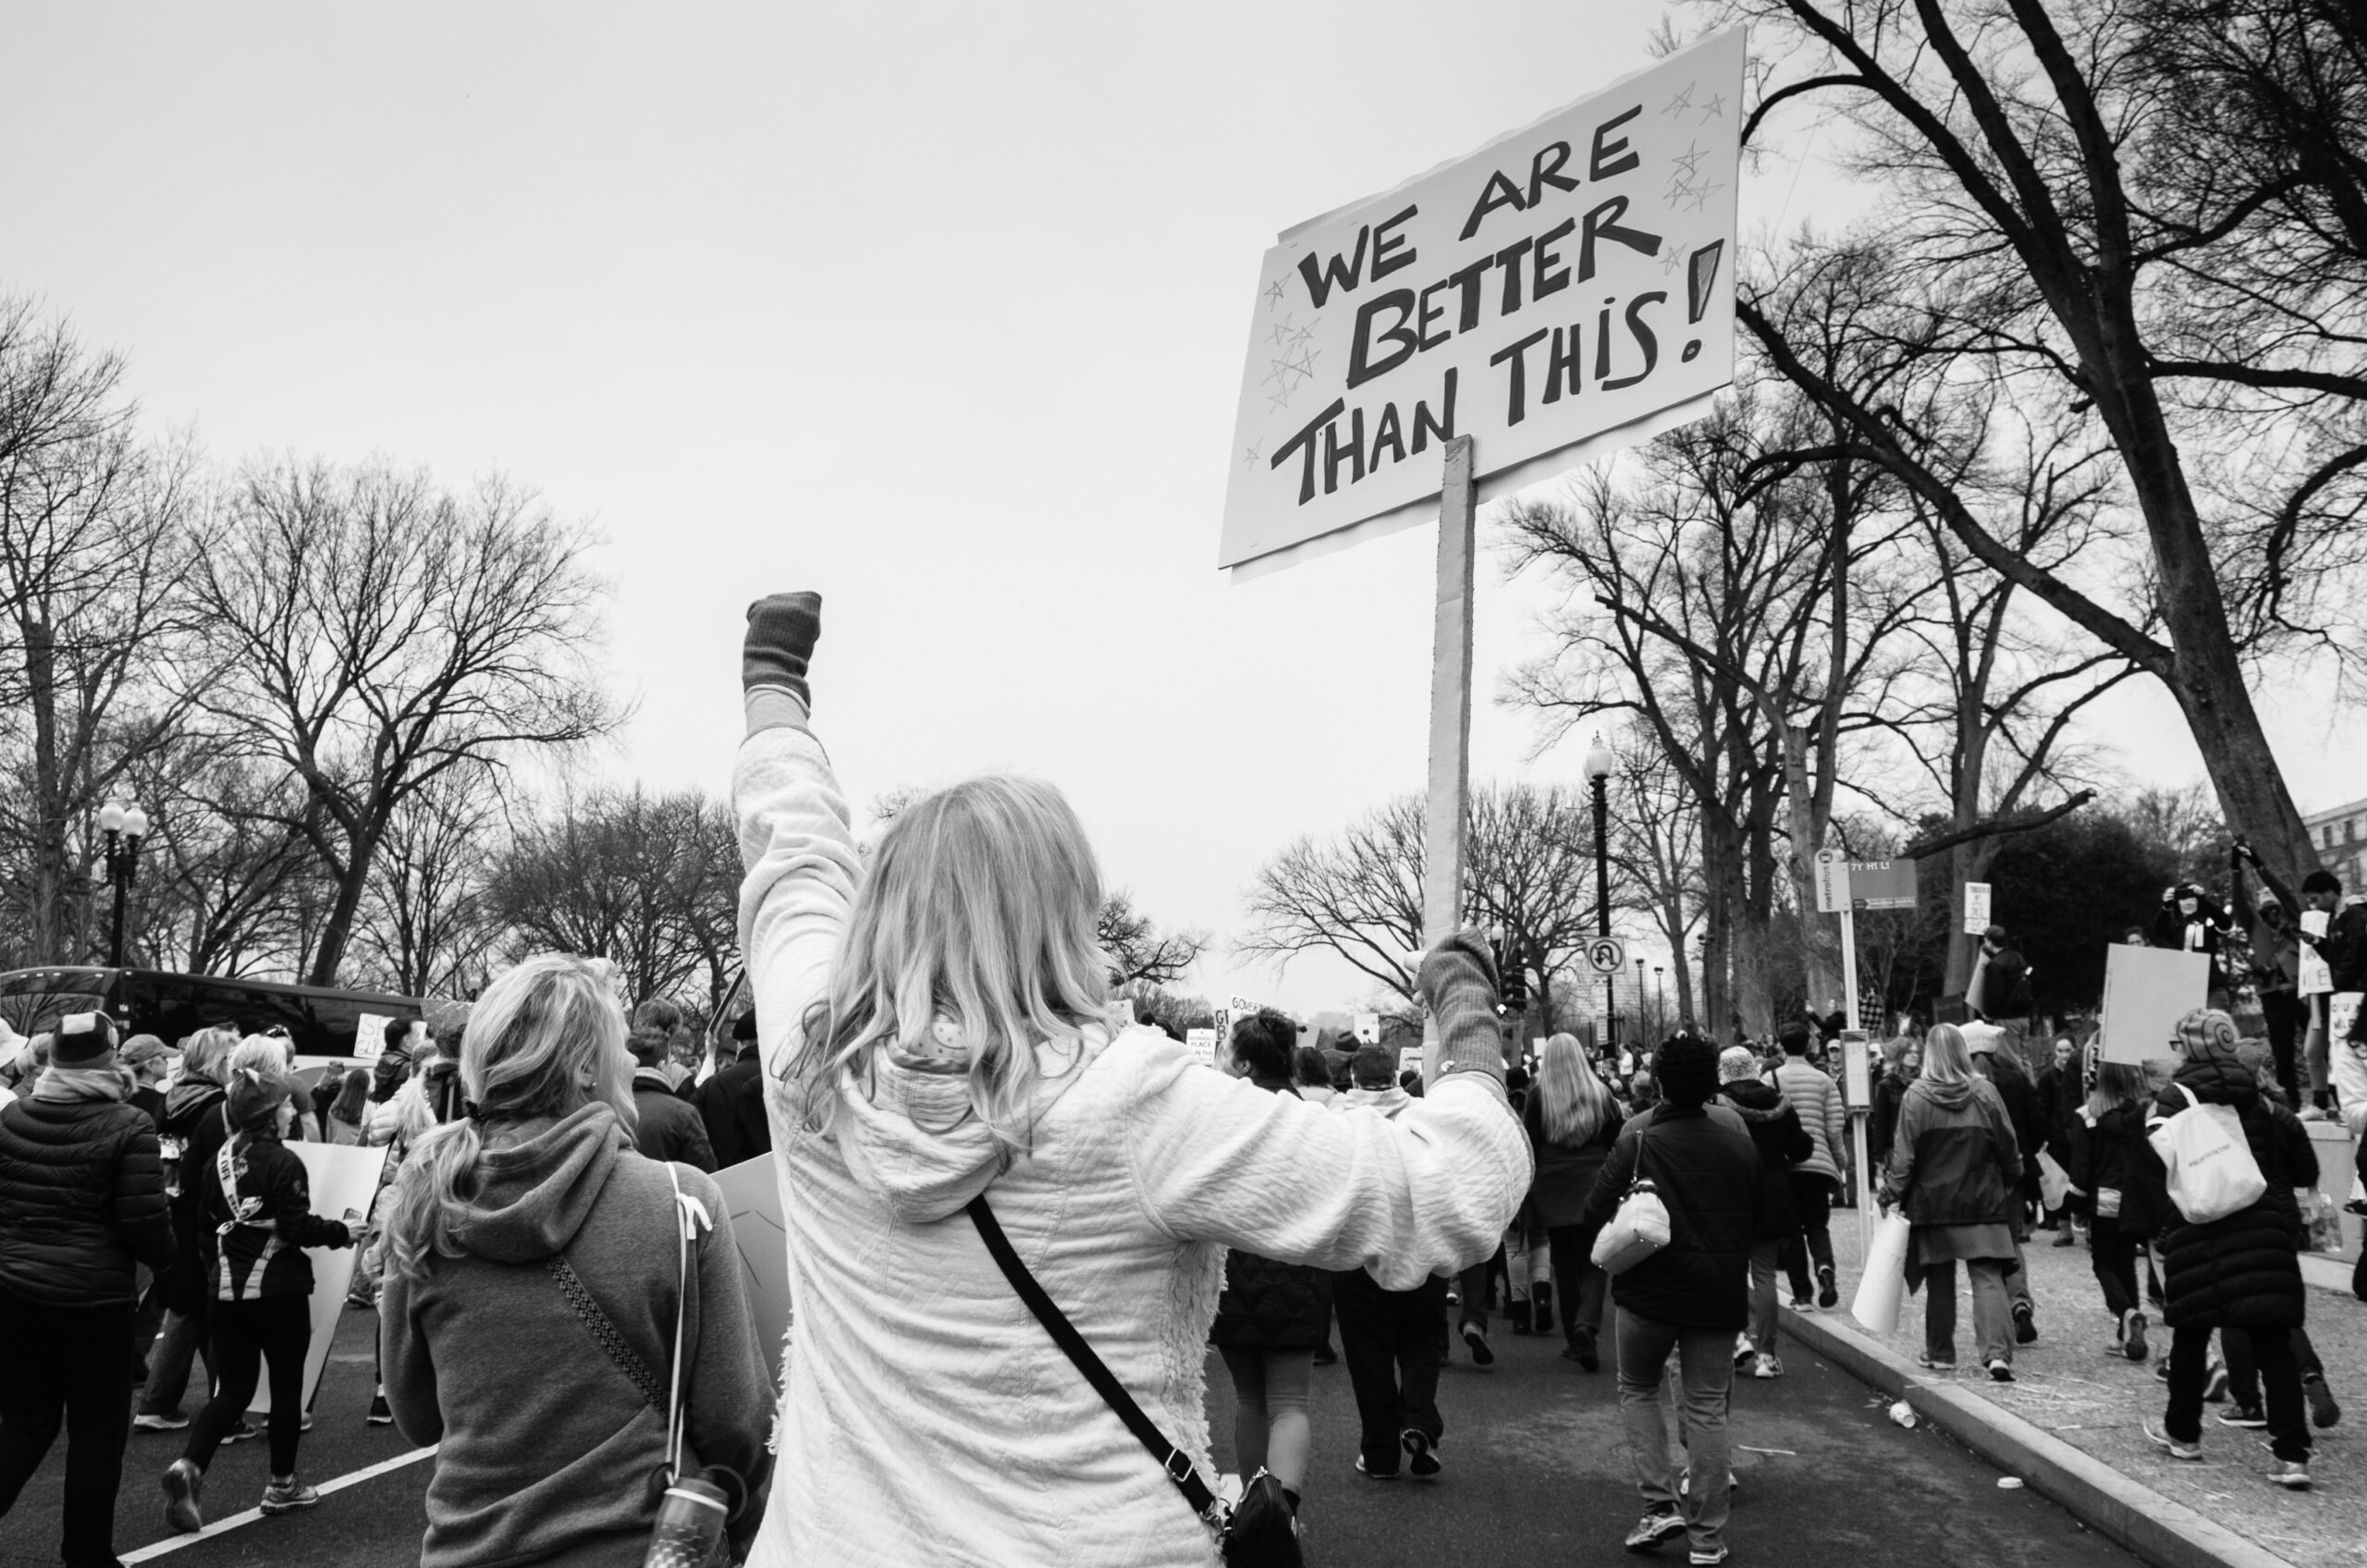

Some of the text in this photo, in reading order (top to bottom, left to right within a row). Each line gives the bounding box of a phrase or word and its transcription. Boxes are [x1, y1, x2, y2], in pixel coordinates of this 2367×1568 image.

[1297, 104, 1642, 309] WE ARE
[1346, 194, 1662, 389] BETTER
[1271, 366, 1458, 507] THAN
[1821, 865, 1833, 910] metrobus
